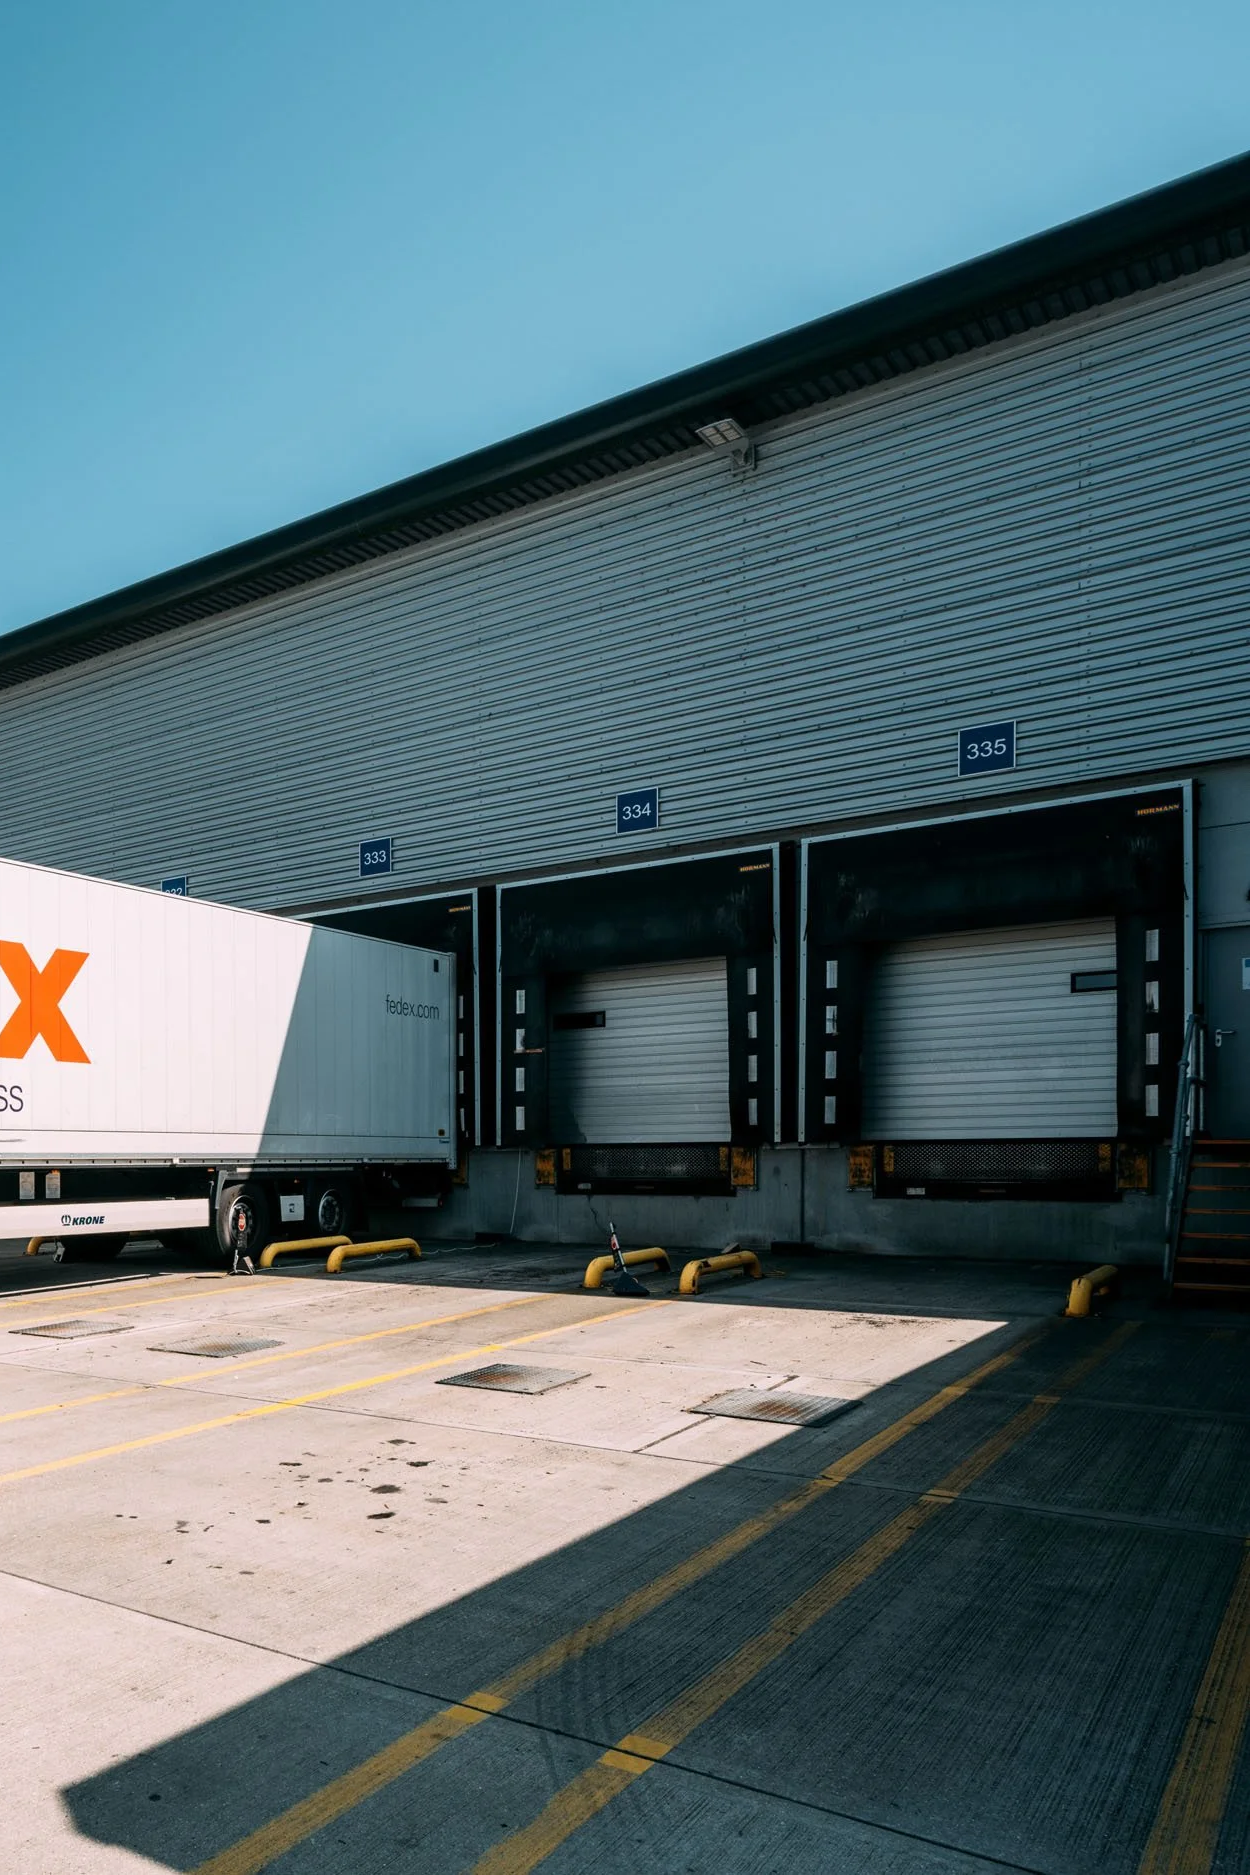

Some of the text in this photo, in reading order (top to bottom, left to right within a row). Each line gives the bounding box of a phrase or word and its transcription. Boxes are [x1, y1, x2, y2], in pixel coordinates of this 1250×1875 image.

[966, 738, 1007, 760] 335
[622, 802, 652, 820] 334
[363, 850, 387, 866] 333
[385, 993, 440, 1020] fedex.com
[72, 1215, 105, 1226] KRONE
